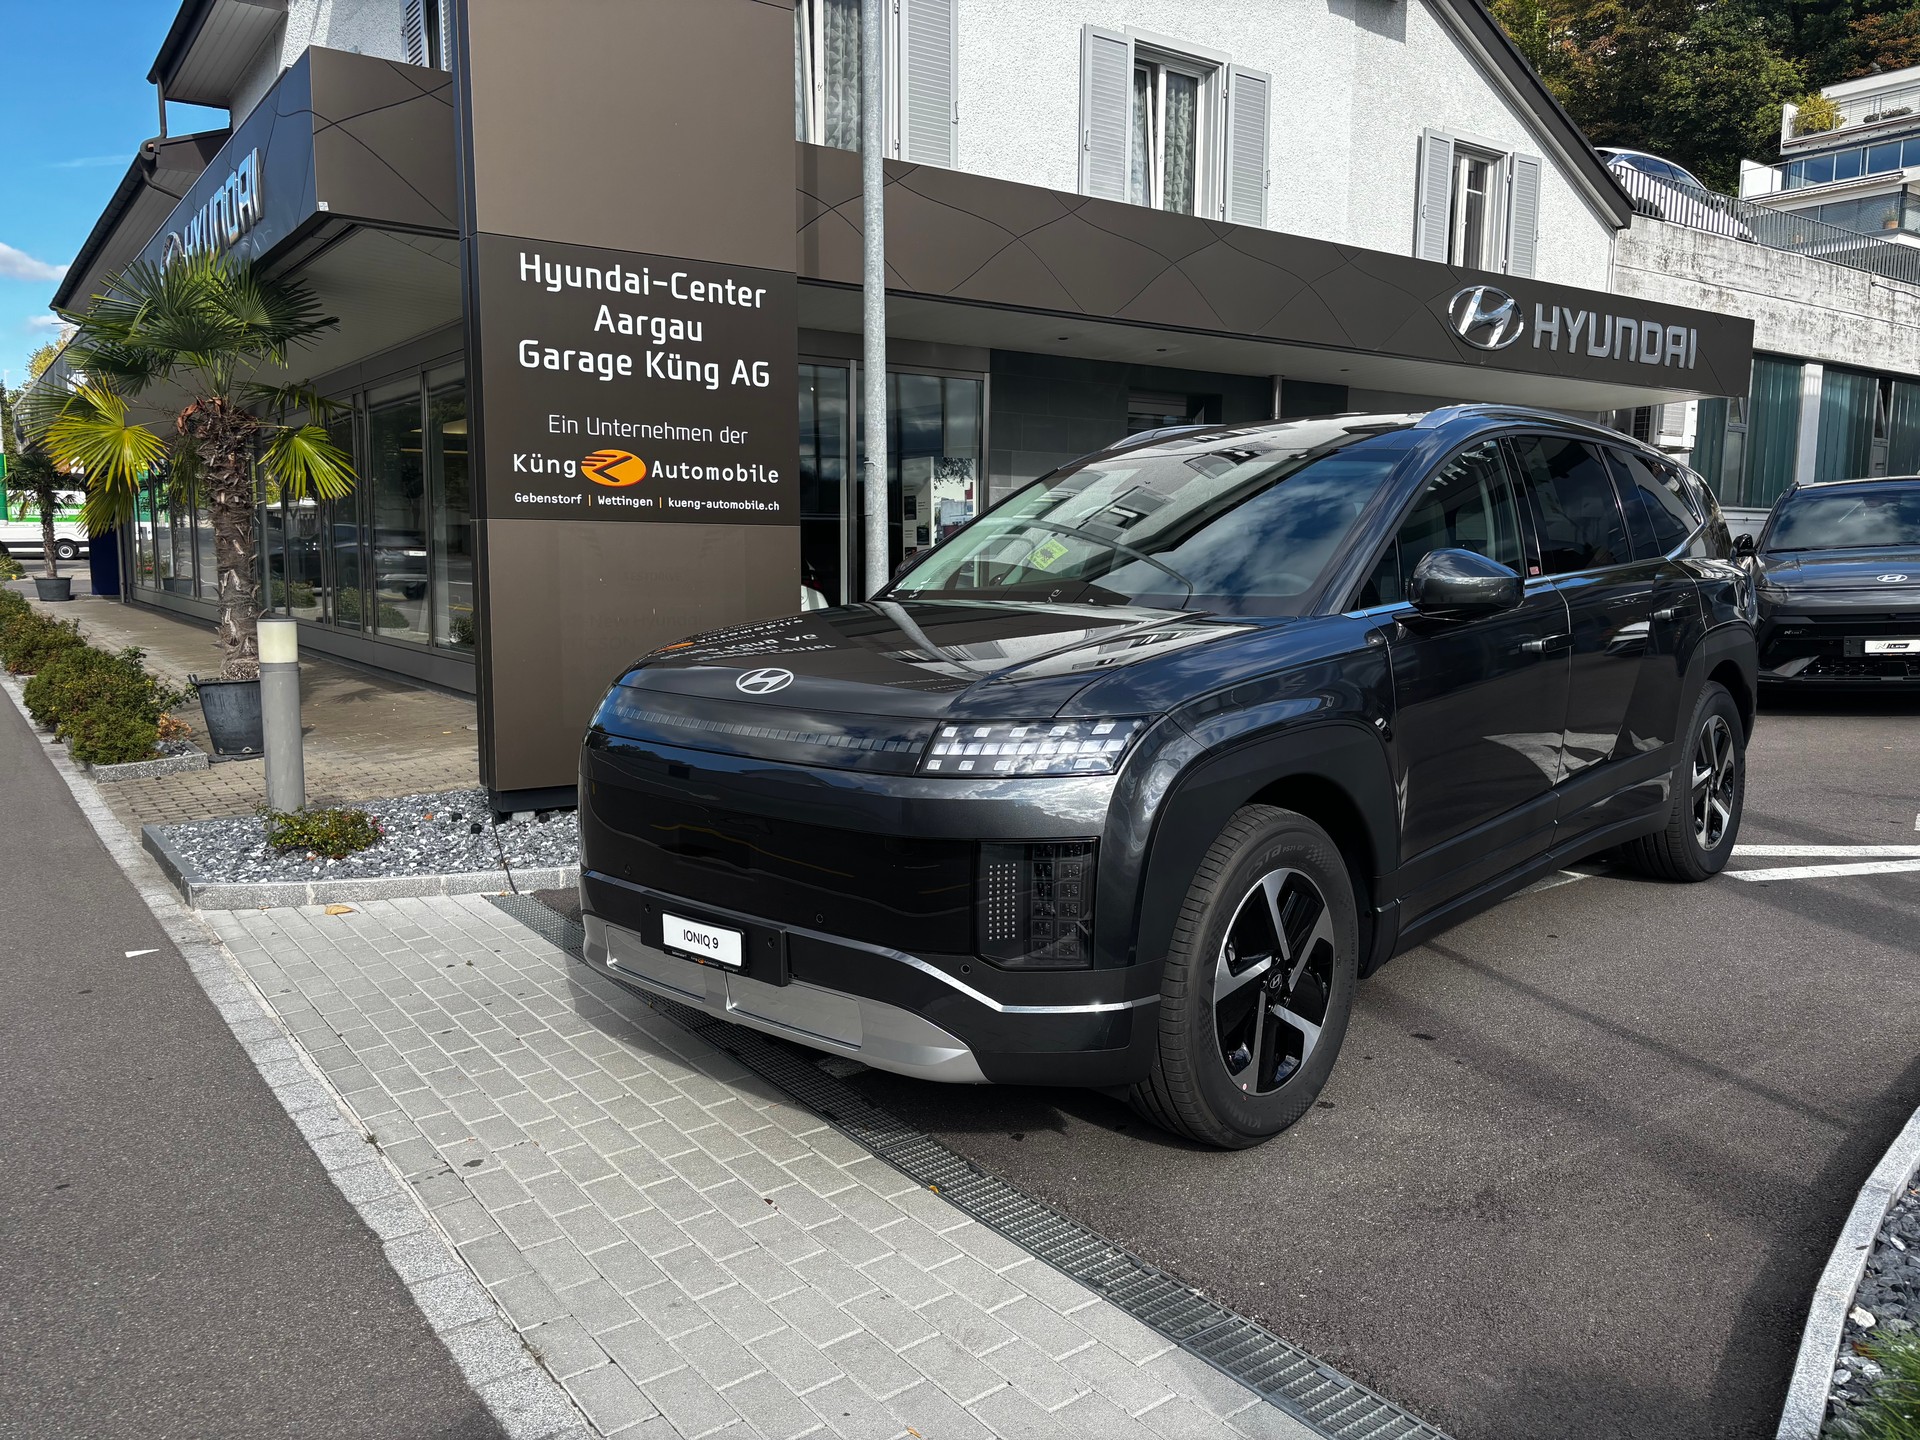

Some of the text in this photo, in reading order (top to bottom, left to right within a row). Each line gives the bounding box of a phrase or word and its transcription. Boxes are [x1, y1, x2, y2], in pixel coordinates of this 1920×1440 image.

[520, 253, 766, 308] Hyundai-Center
[594, 304, 702, 344] Aargau
[1533, 302, 1697, 370] HYUNDAI
[519, 340, 769, 389] Garage Küng AG
[549, 415, 748, 443] Ein Unternehmen der
[514, 454, 778, 483] Küng Automobile
[515, 493, 779, 510] Gebenstorf Wettingen kueng-automobile.ch
[683, 929, 719, 949] IONIQ 9
